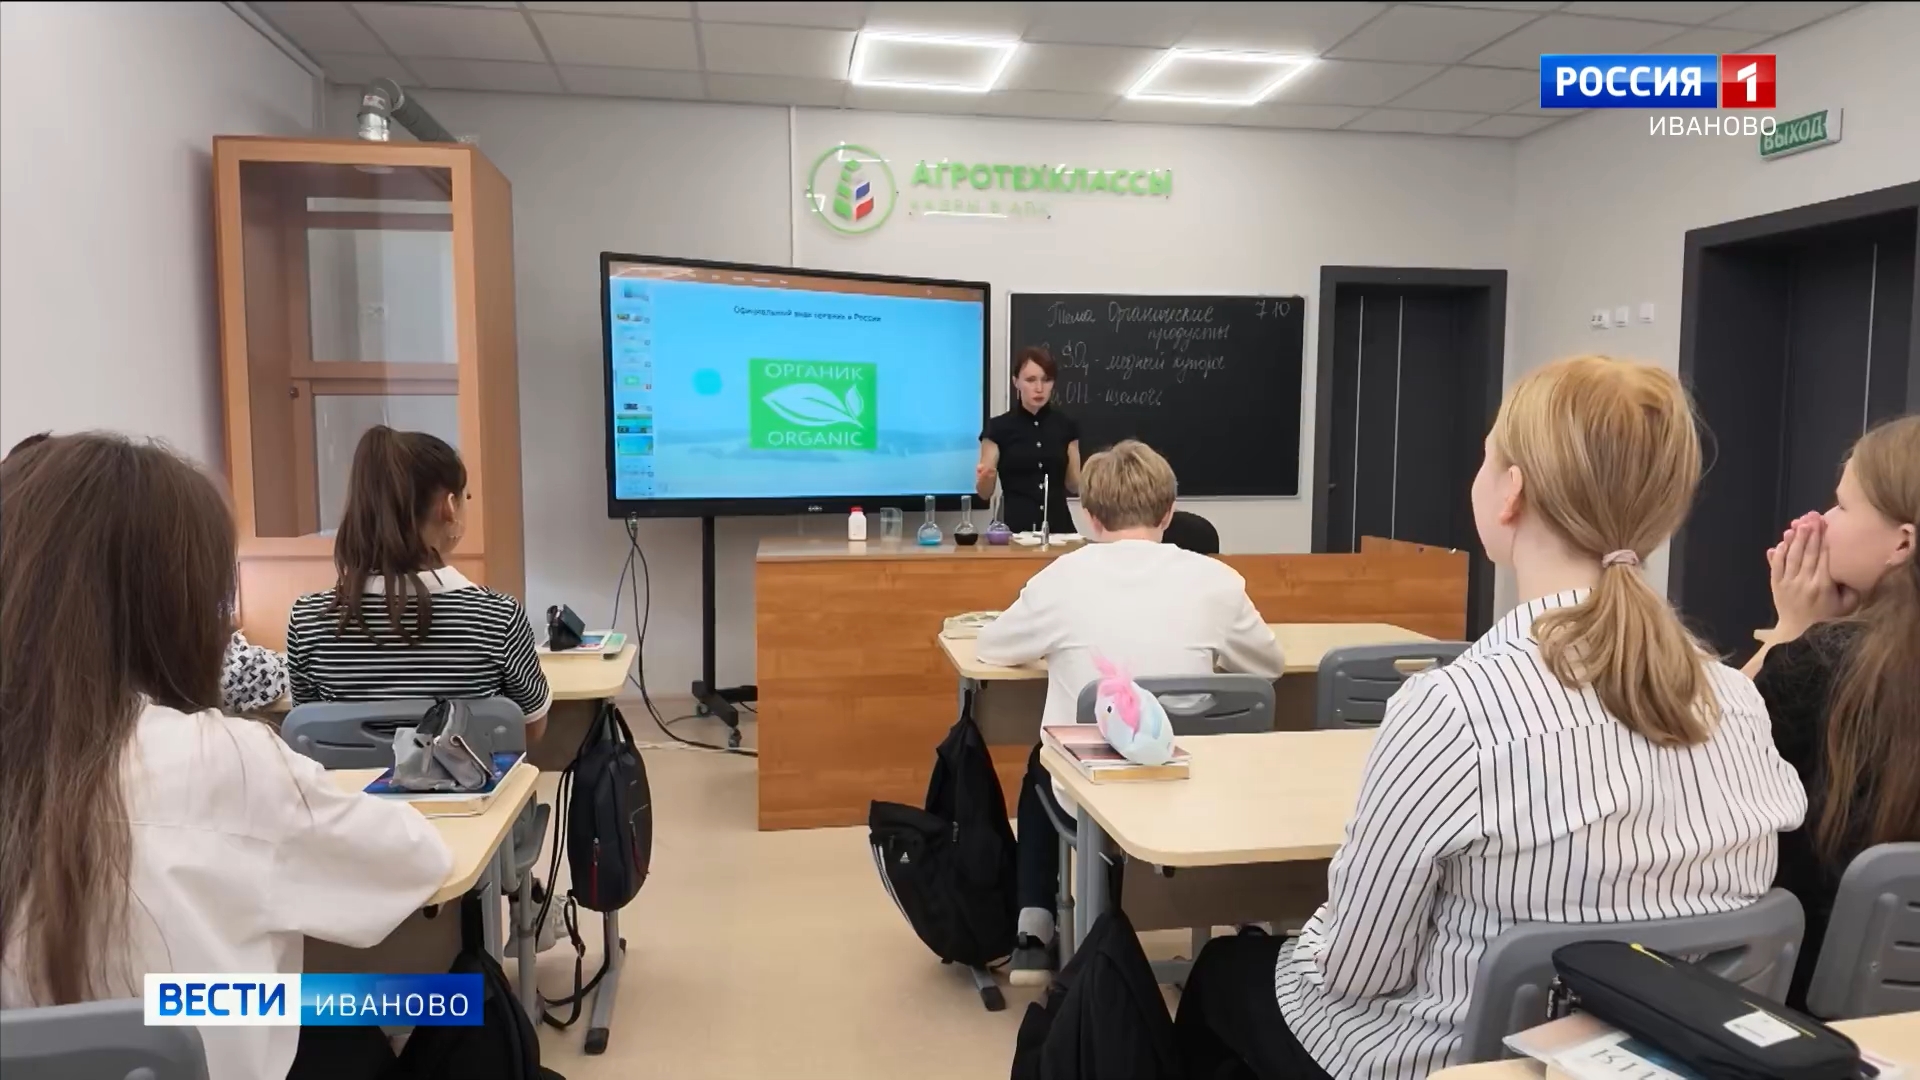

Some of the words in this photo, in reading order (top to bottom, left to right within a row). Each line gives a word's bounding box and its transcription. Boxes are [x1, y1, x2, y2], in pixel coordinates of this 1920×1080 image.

[1764, 116, 1823, 151] ВЫХОД
[911, 160, 1173, 196] АГРОТЕХКЛАССЫ
[764, 363, 864, 381] ОРГАНИК
[768, 431, 863, 446] ORGANIC
